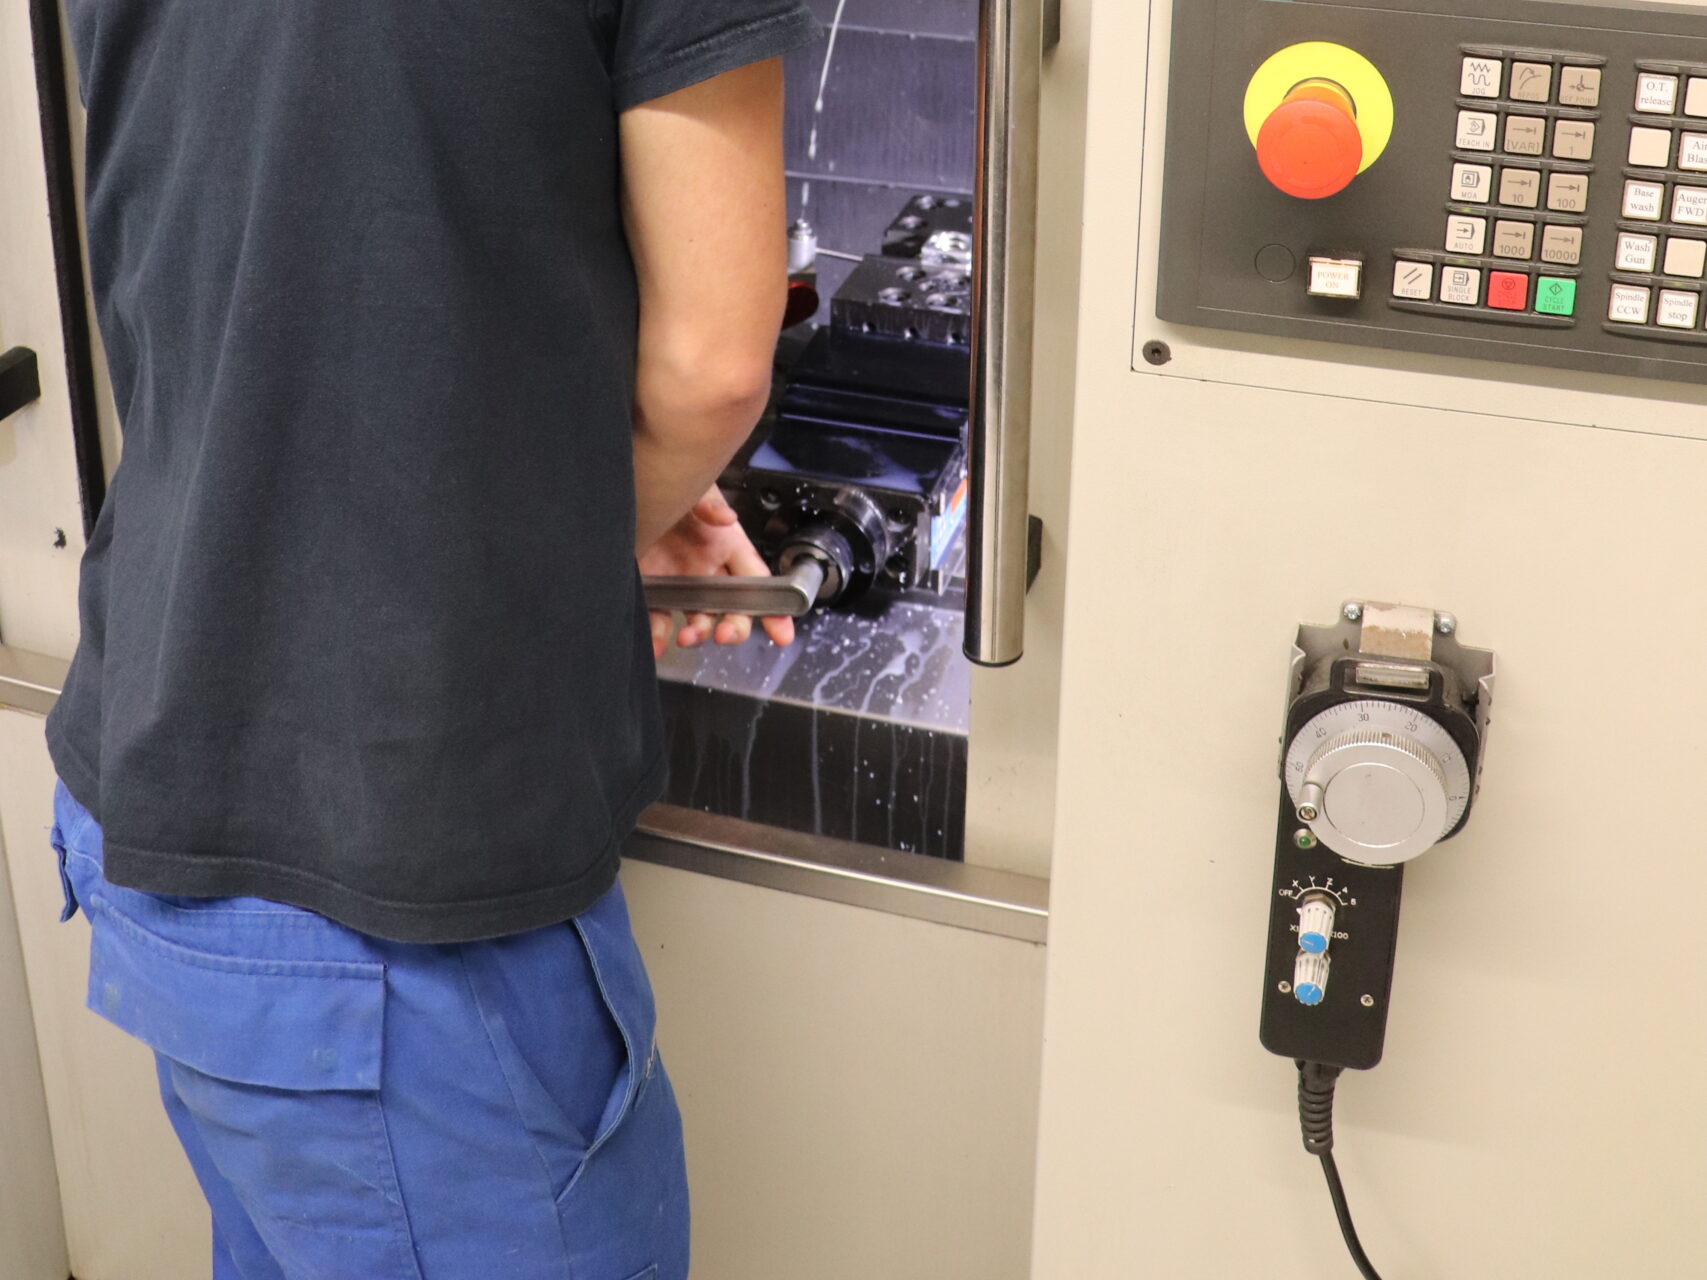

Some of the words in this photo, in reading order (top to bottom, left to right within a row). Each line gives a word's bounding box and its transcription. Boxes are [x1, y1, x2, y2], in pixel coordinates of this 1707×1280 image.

[1640, 96, 1672, 106] release
[1459, 138, 1480, 147] TEACH
[1482, 139, 1490, 147] IN
[1507, 139, 1539, 153] [VAR]
[1568, 146, 1573, 155] 1
[1461, 192, 1477, 200] MDA
[1634, 188, 1655, 198] Base
[1512, 194, 1524, 204] 10
[1557, 198, 1576, 209] 100
[1630, 202, 1654, 212] wash
[1678, 206, 1704, 216] FWD
[1500, 245, 1525, 257] 1000
[1625, 241, 1650, 252] Wash
[1544, 249, 1577, 261] 10000
[1625, 254, 1645, 265] Gun
[1401, 288, 1423, 297] RESET
[1447, 285, 1471, 295] SINGLE
[1448, 293, 1470, 302] BLOCK
[1615, 292, 1644, 303] Spindle
[1664, 297, 1693, 308] Spindle
[1617, 305, 1641, 315] CCW
[1668, 310, 1688, 321] stop
[1359, 713, 1369, 722] 30
[1404, 721, 1418, 732] 20
[1315, 727, 1327, 739] 40
[1331, 932, 1349, 940] 100
